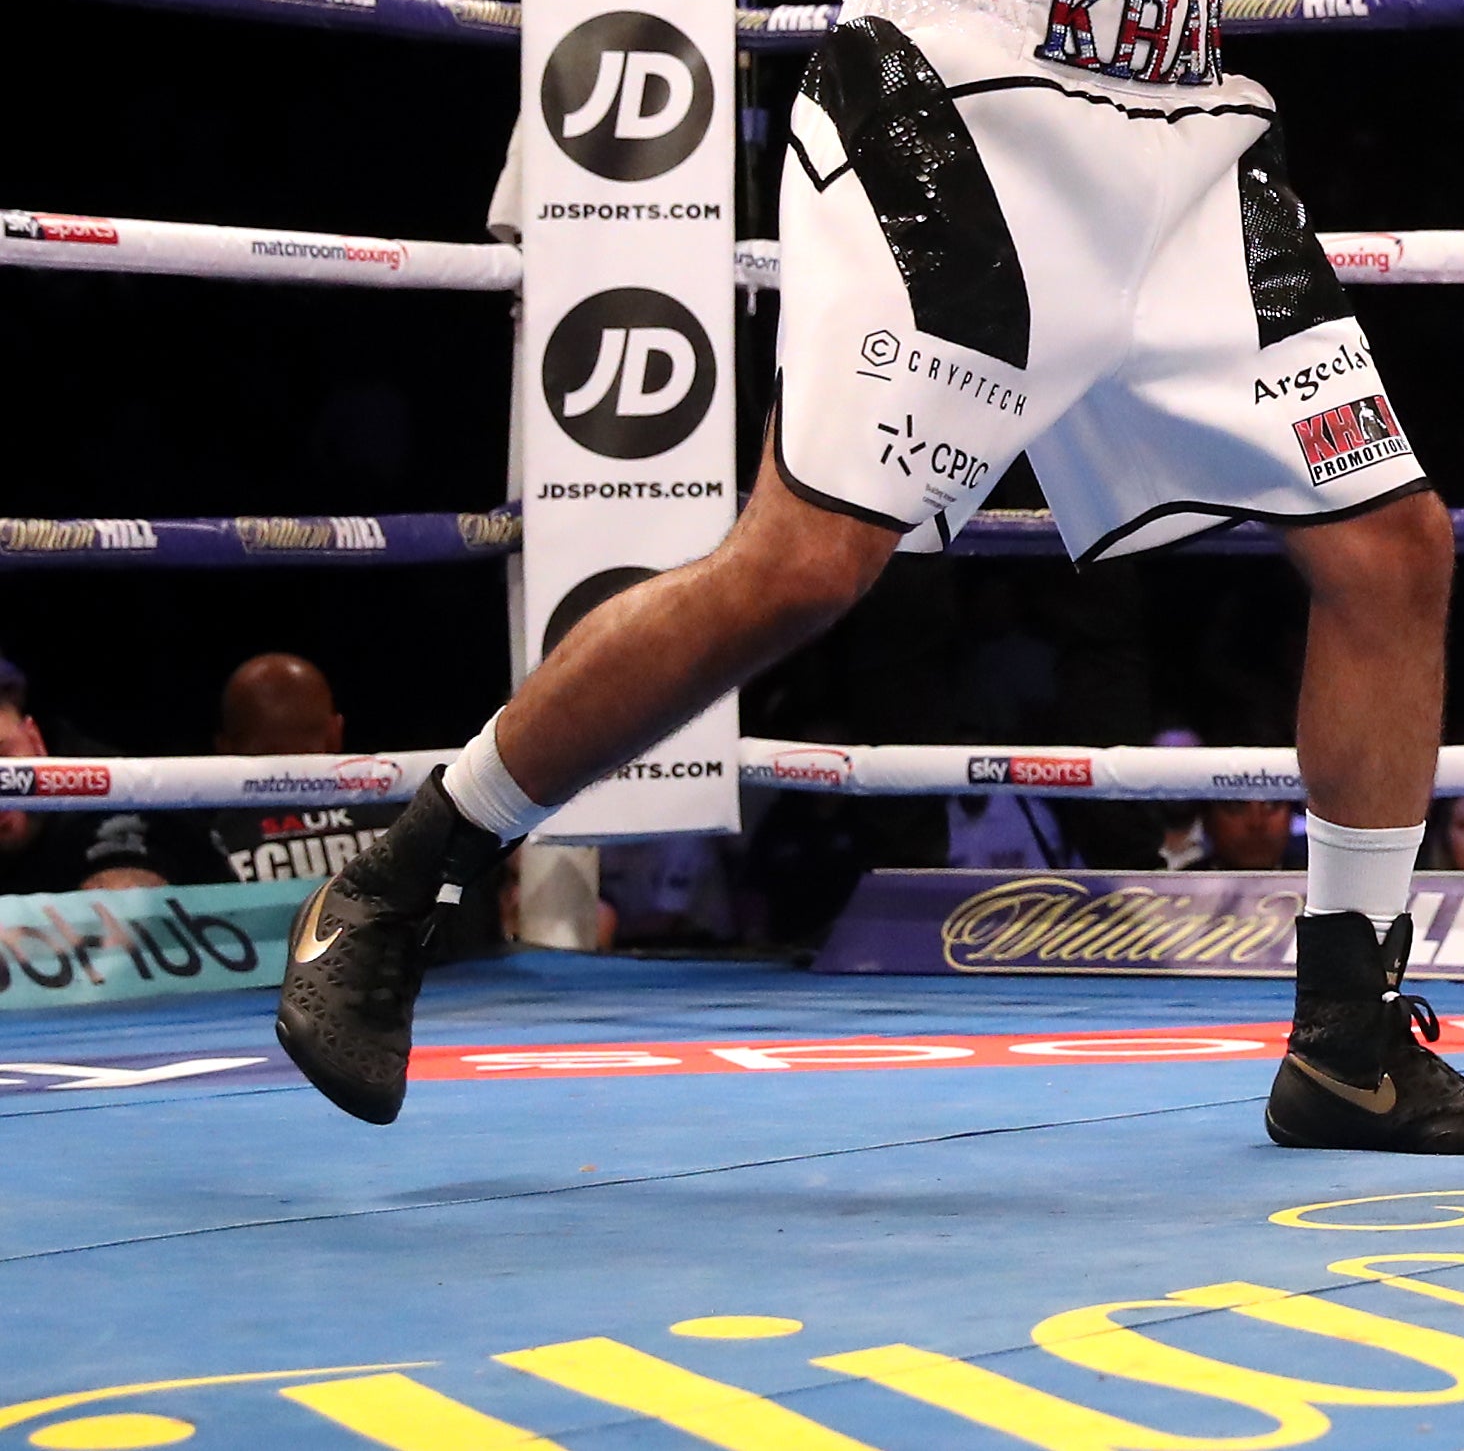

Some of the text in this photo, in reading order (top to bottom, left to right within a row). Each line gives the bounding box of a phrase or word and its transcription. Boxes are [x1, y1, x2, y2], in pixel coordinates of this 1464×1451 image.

[562, 50, 695, 140] JD
[538, 203, 722, 221] JDSPORTS.COM
[563, 327, 697, 418] JD
[908, 350, 1028, 416] CRYPTECH
[931, 442, 989, 489] CPIC
[538, 481, 724, 500] JDSPORTS.COM
[37, 766, 109, 796] sports
[971, 758, 1089, 785] sky sports
[942, 877, 1304, 970] William
